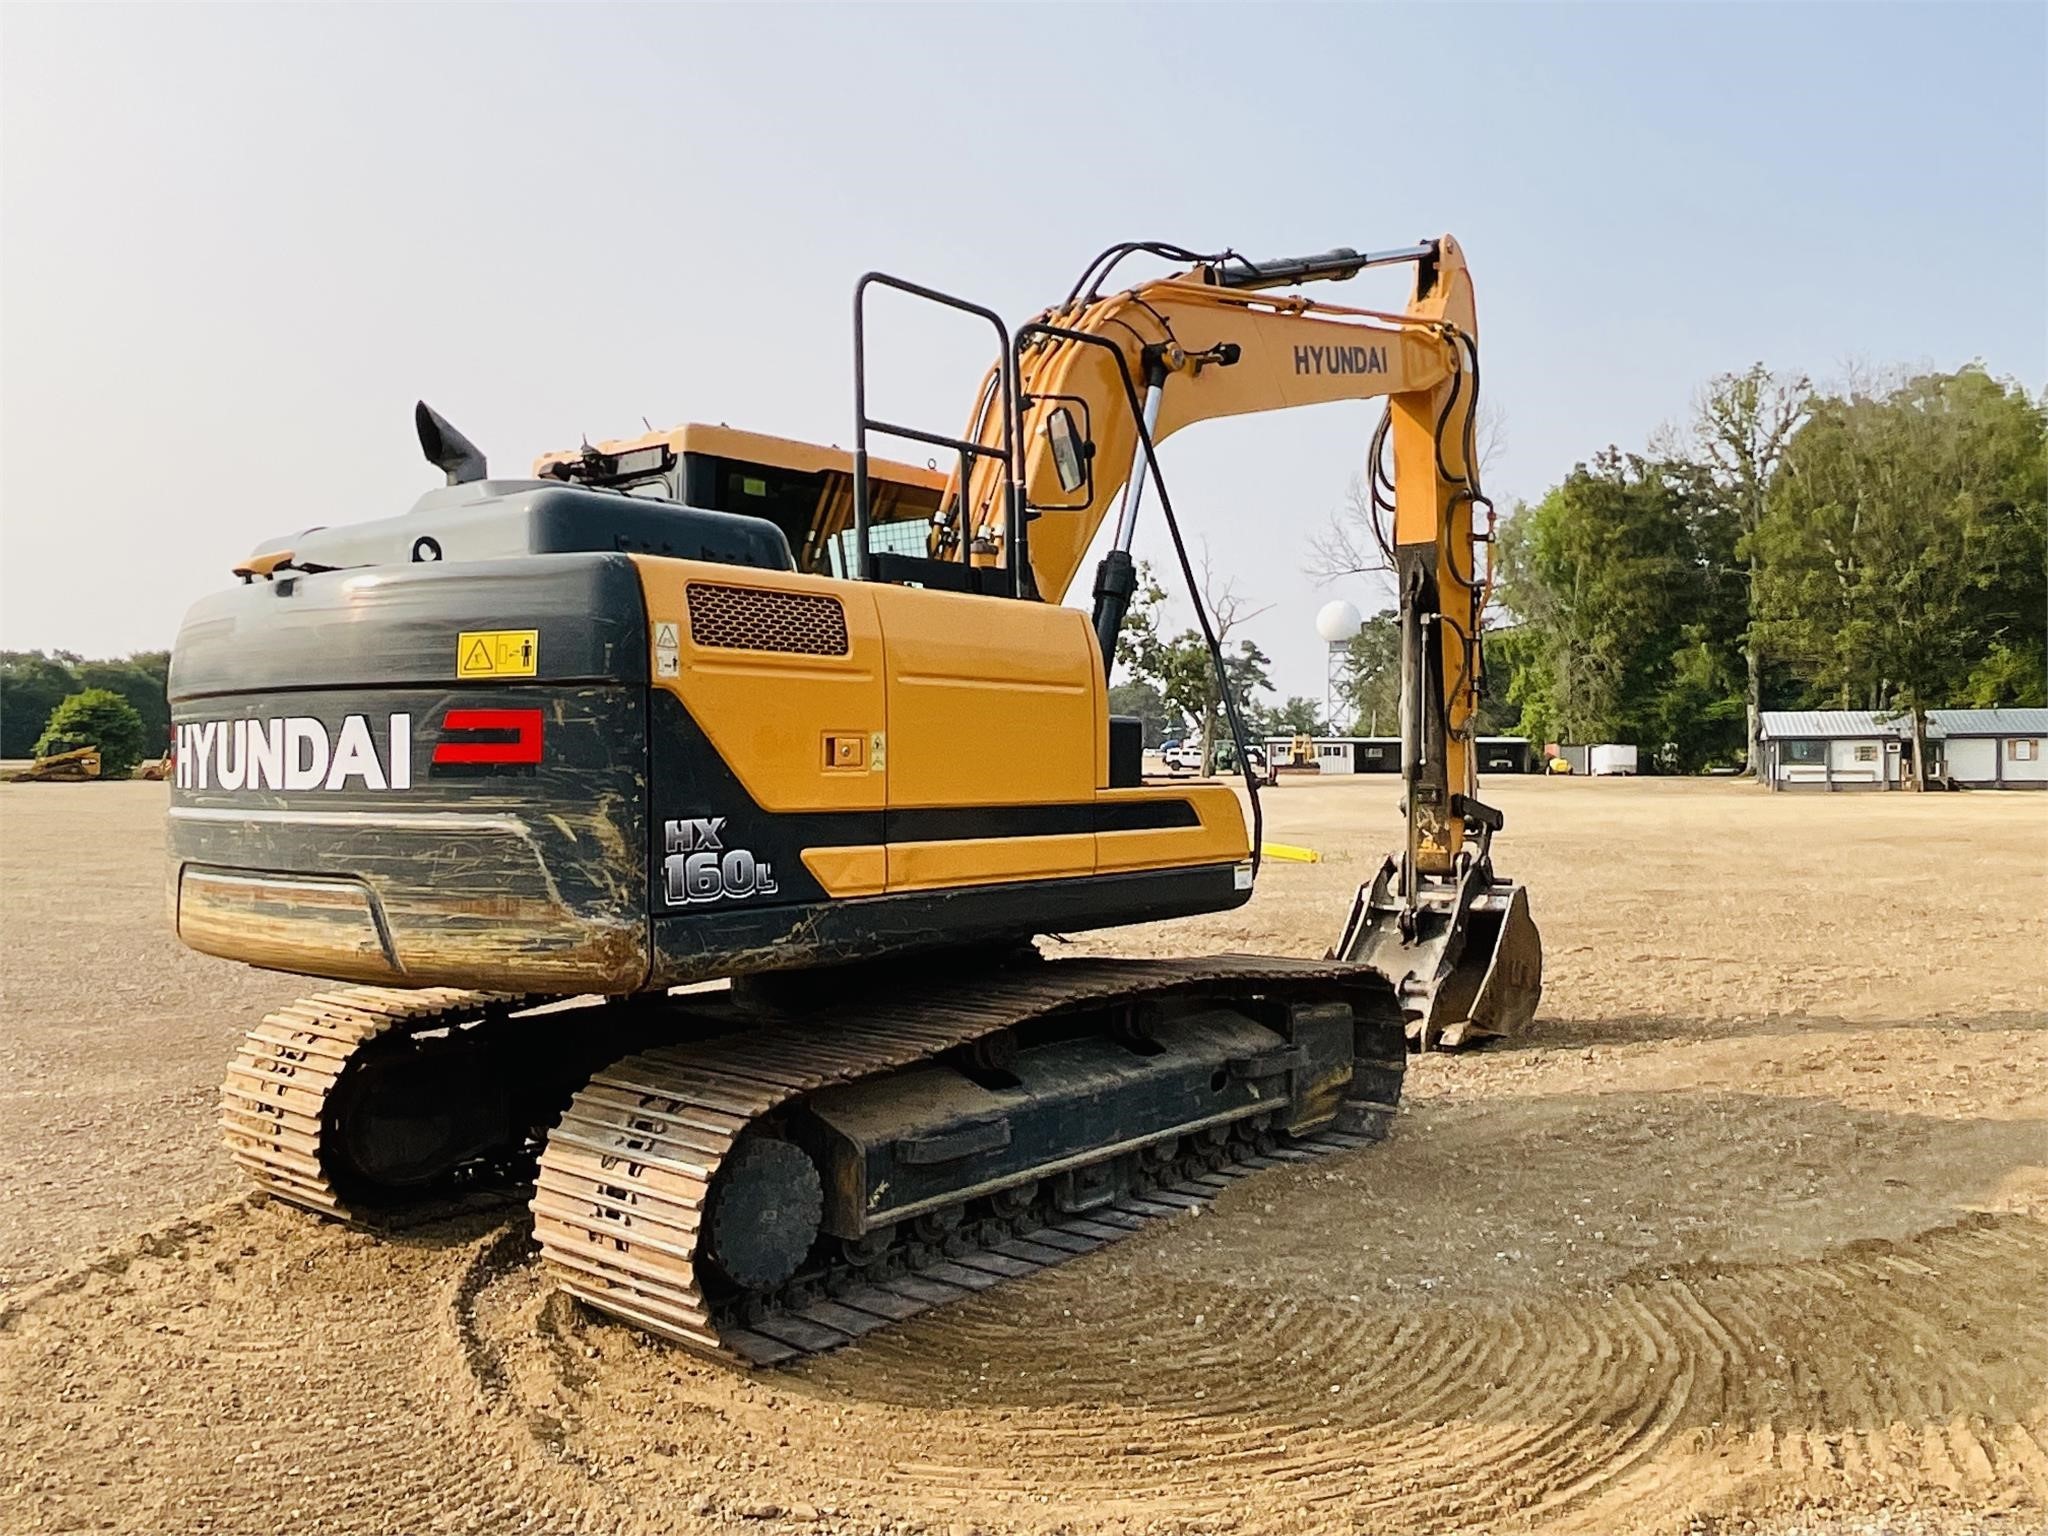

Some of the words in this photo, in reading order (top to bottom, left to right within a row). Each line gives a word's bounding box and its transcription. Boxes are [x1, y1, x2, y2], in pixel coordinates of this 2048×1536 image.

[1293, 345, 1388, 375] HYUNDAI
[176, 713, 411, 791] HYUNDAI
[664, 817, 726, 853] HX
[663, 849, 776, 904] 160L
